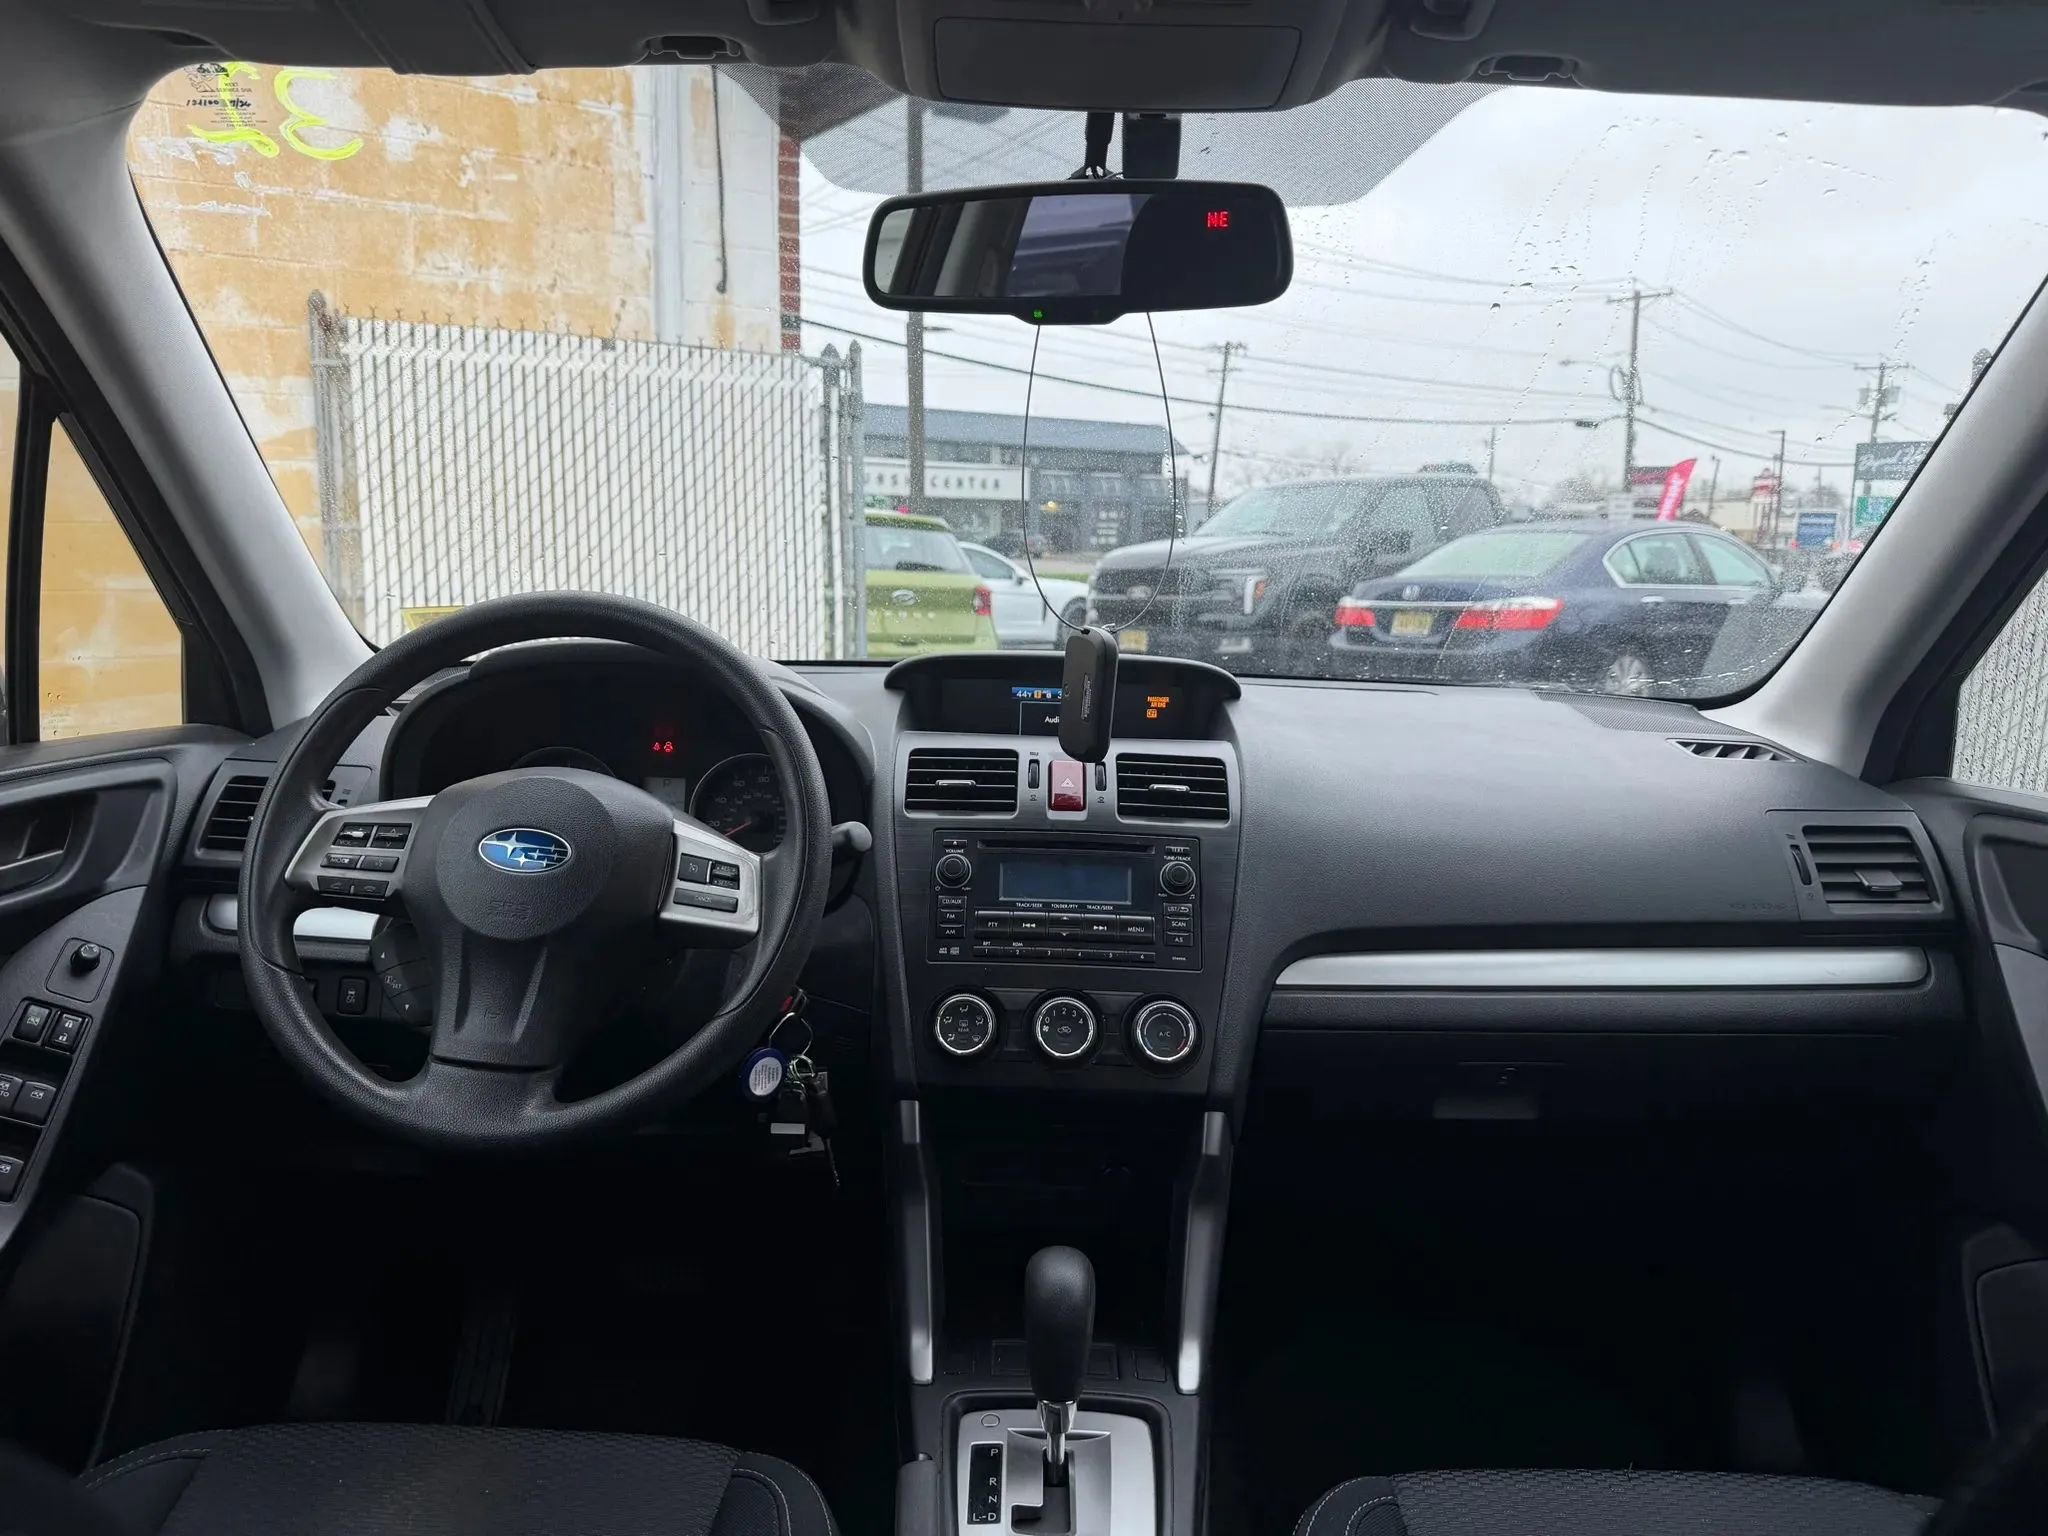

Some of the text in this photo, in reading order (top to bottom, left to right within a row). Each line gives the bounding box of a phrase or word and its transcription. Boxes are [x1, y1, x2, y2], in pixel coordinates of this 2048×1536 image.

[1207, 211, 1228, 228] NE
[930, 474, 999, 490] CENTER
[990, 1448, 999, 1457] P
[989, 1477, 998, 1486] R
[988, 1495, 998, 1503] N
